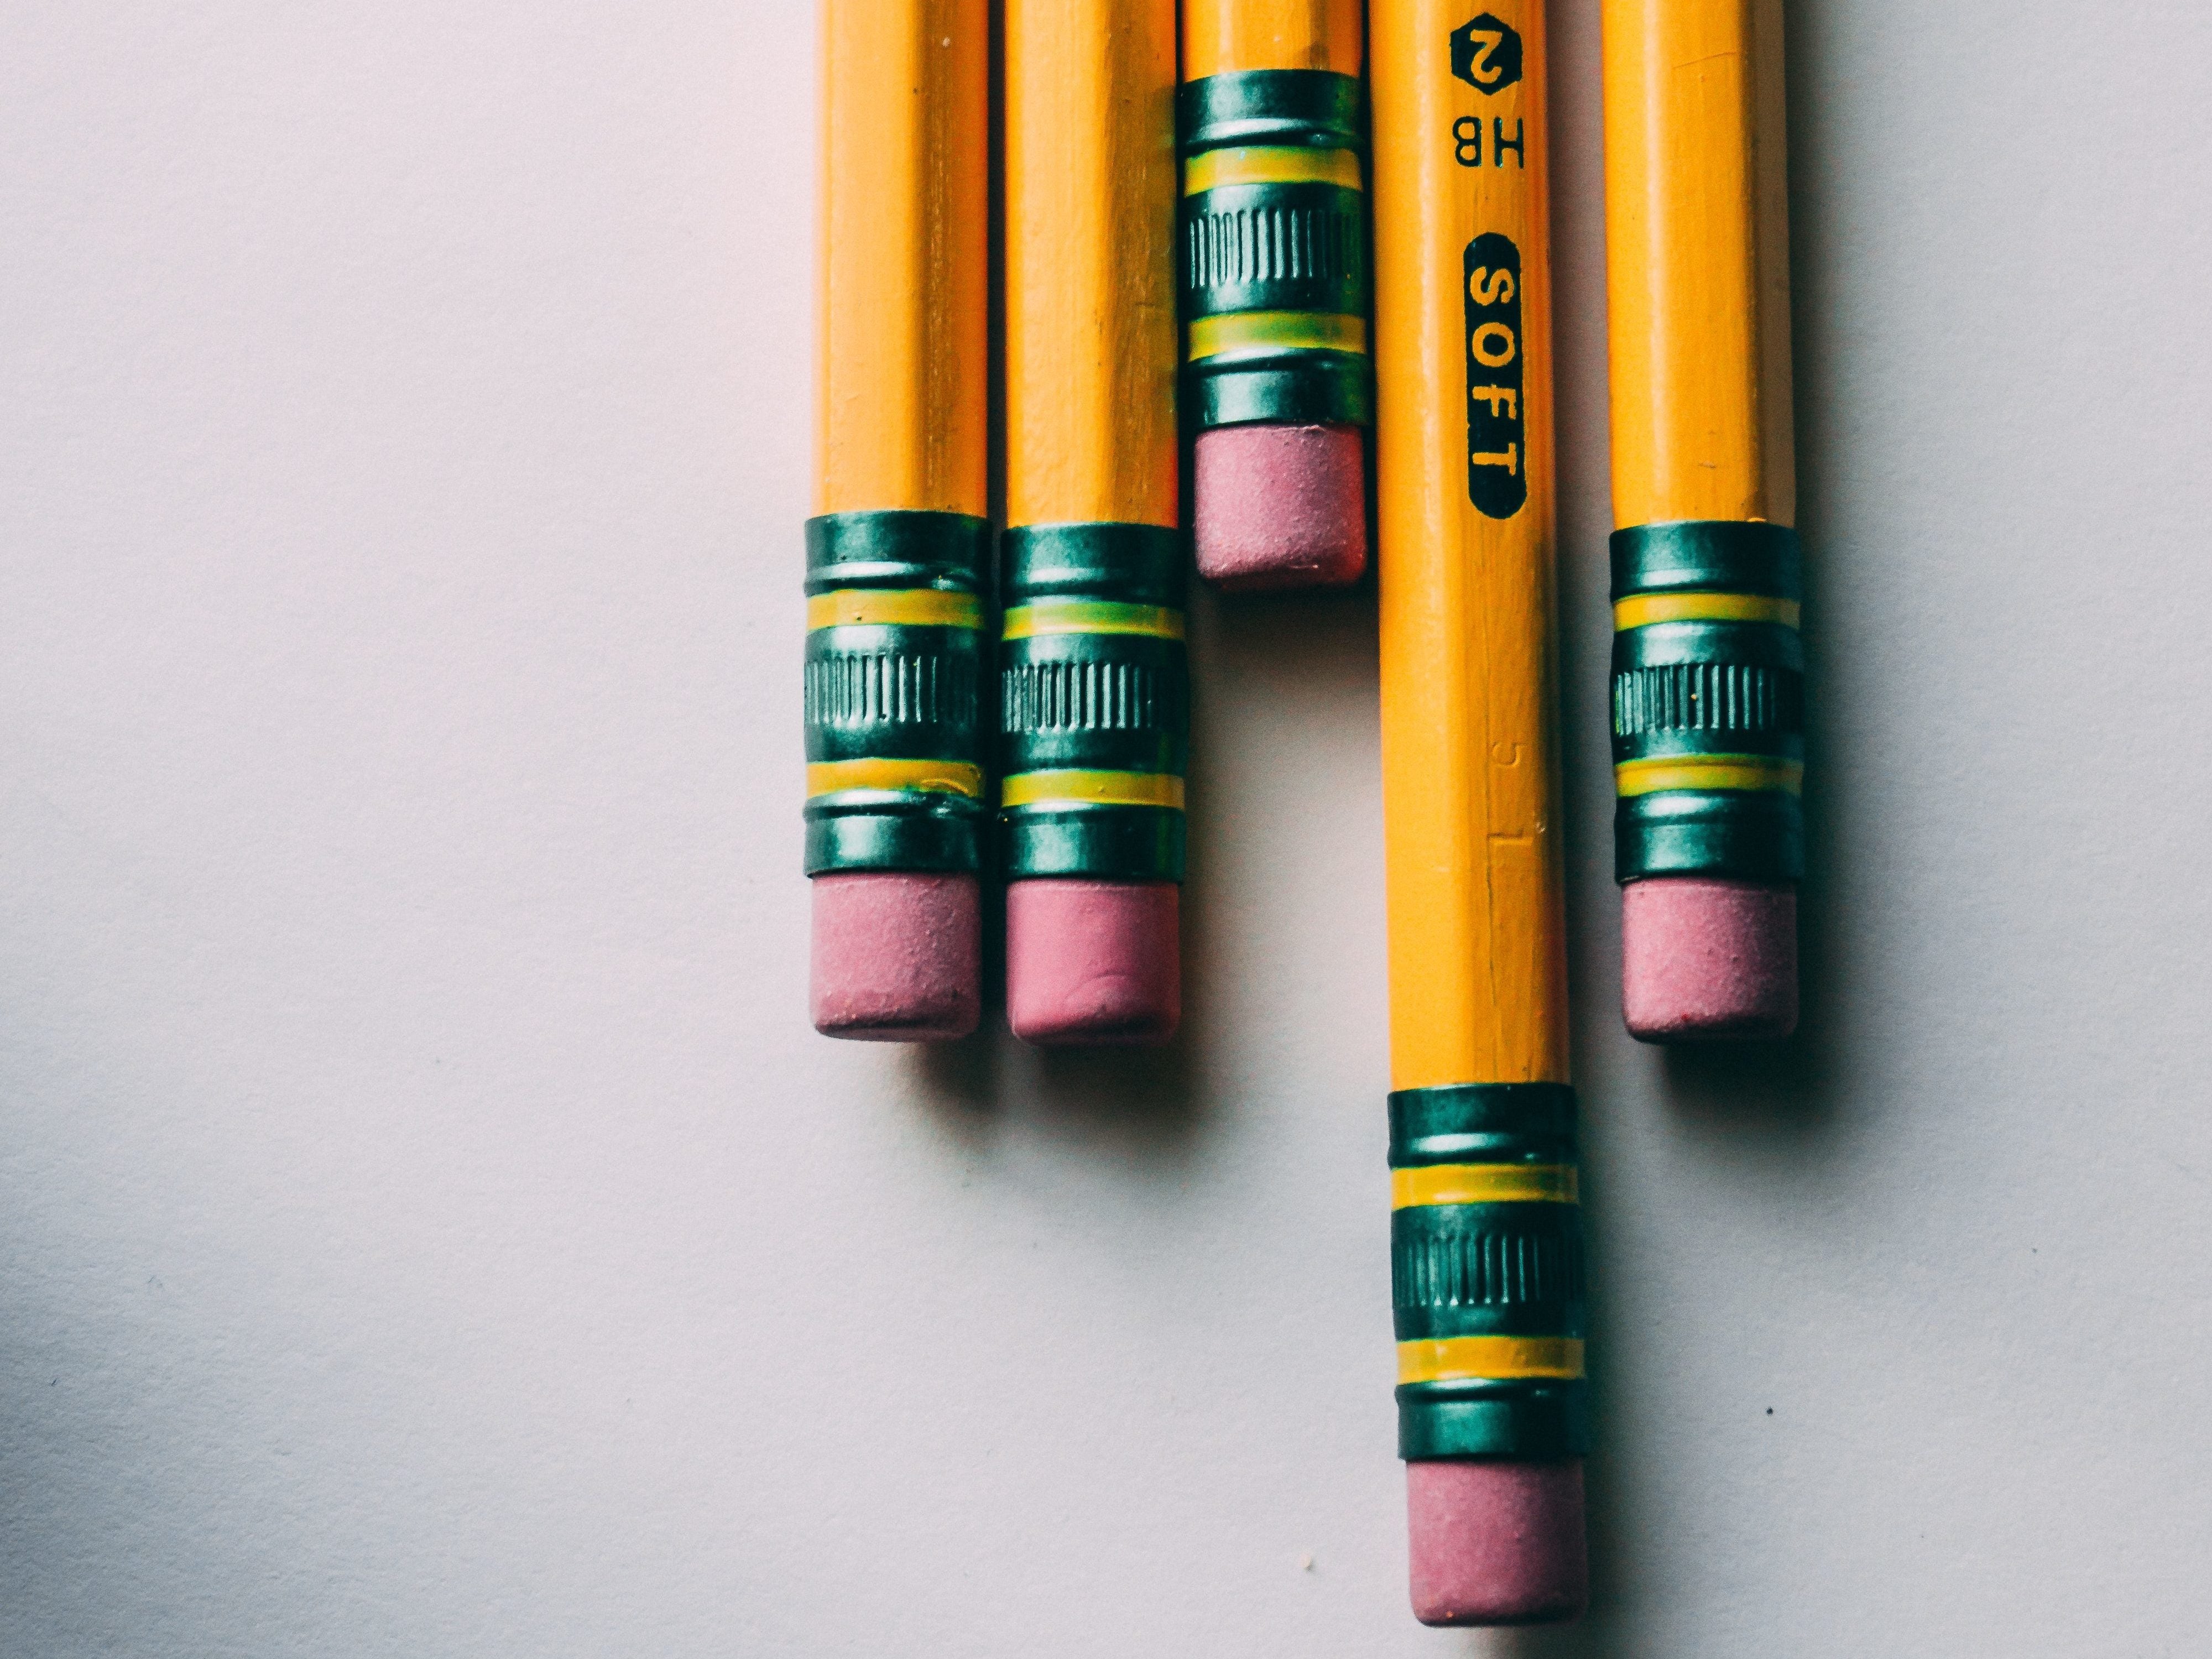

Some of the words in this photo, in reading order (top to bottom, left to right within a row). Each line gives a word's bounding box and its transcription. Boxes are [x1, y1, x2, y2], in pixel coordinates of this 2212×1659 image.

[1469, 29, 1503, 84] 2
[1452, 115, 1525, 169] HB
[1470, 266, 1517, 476] SOFT
